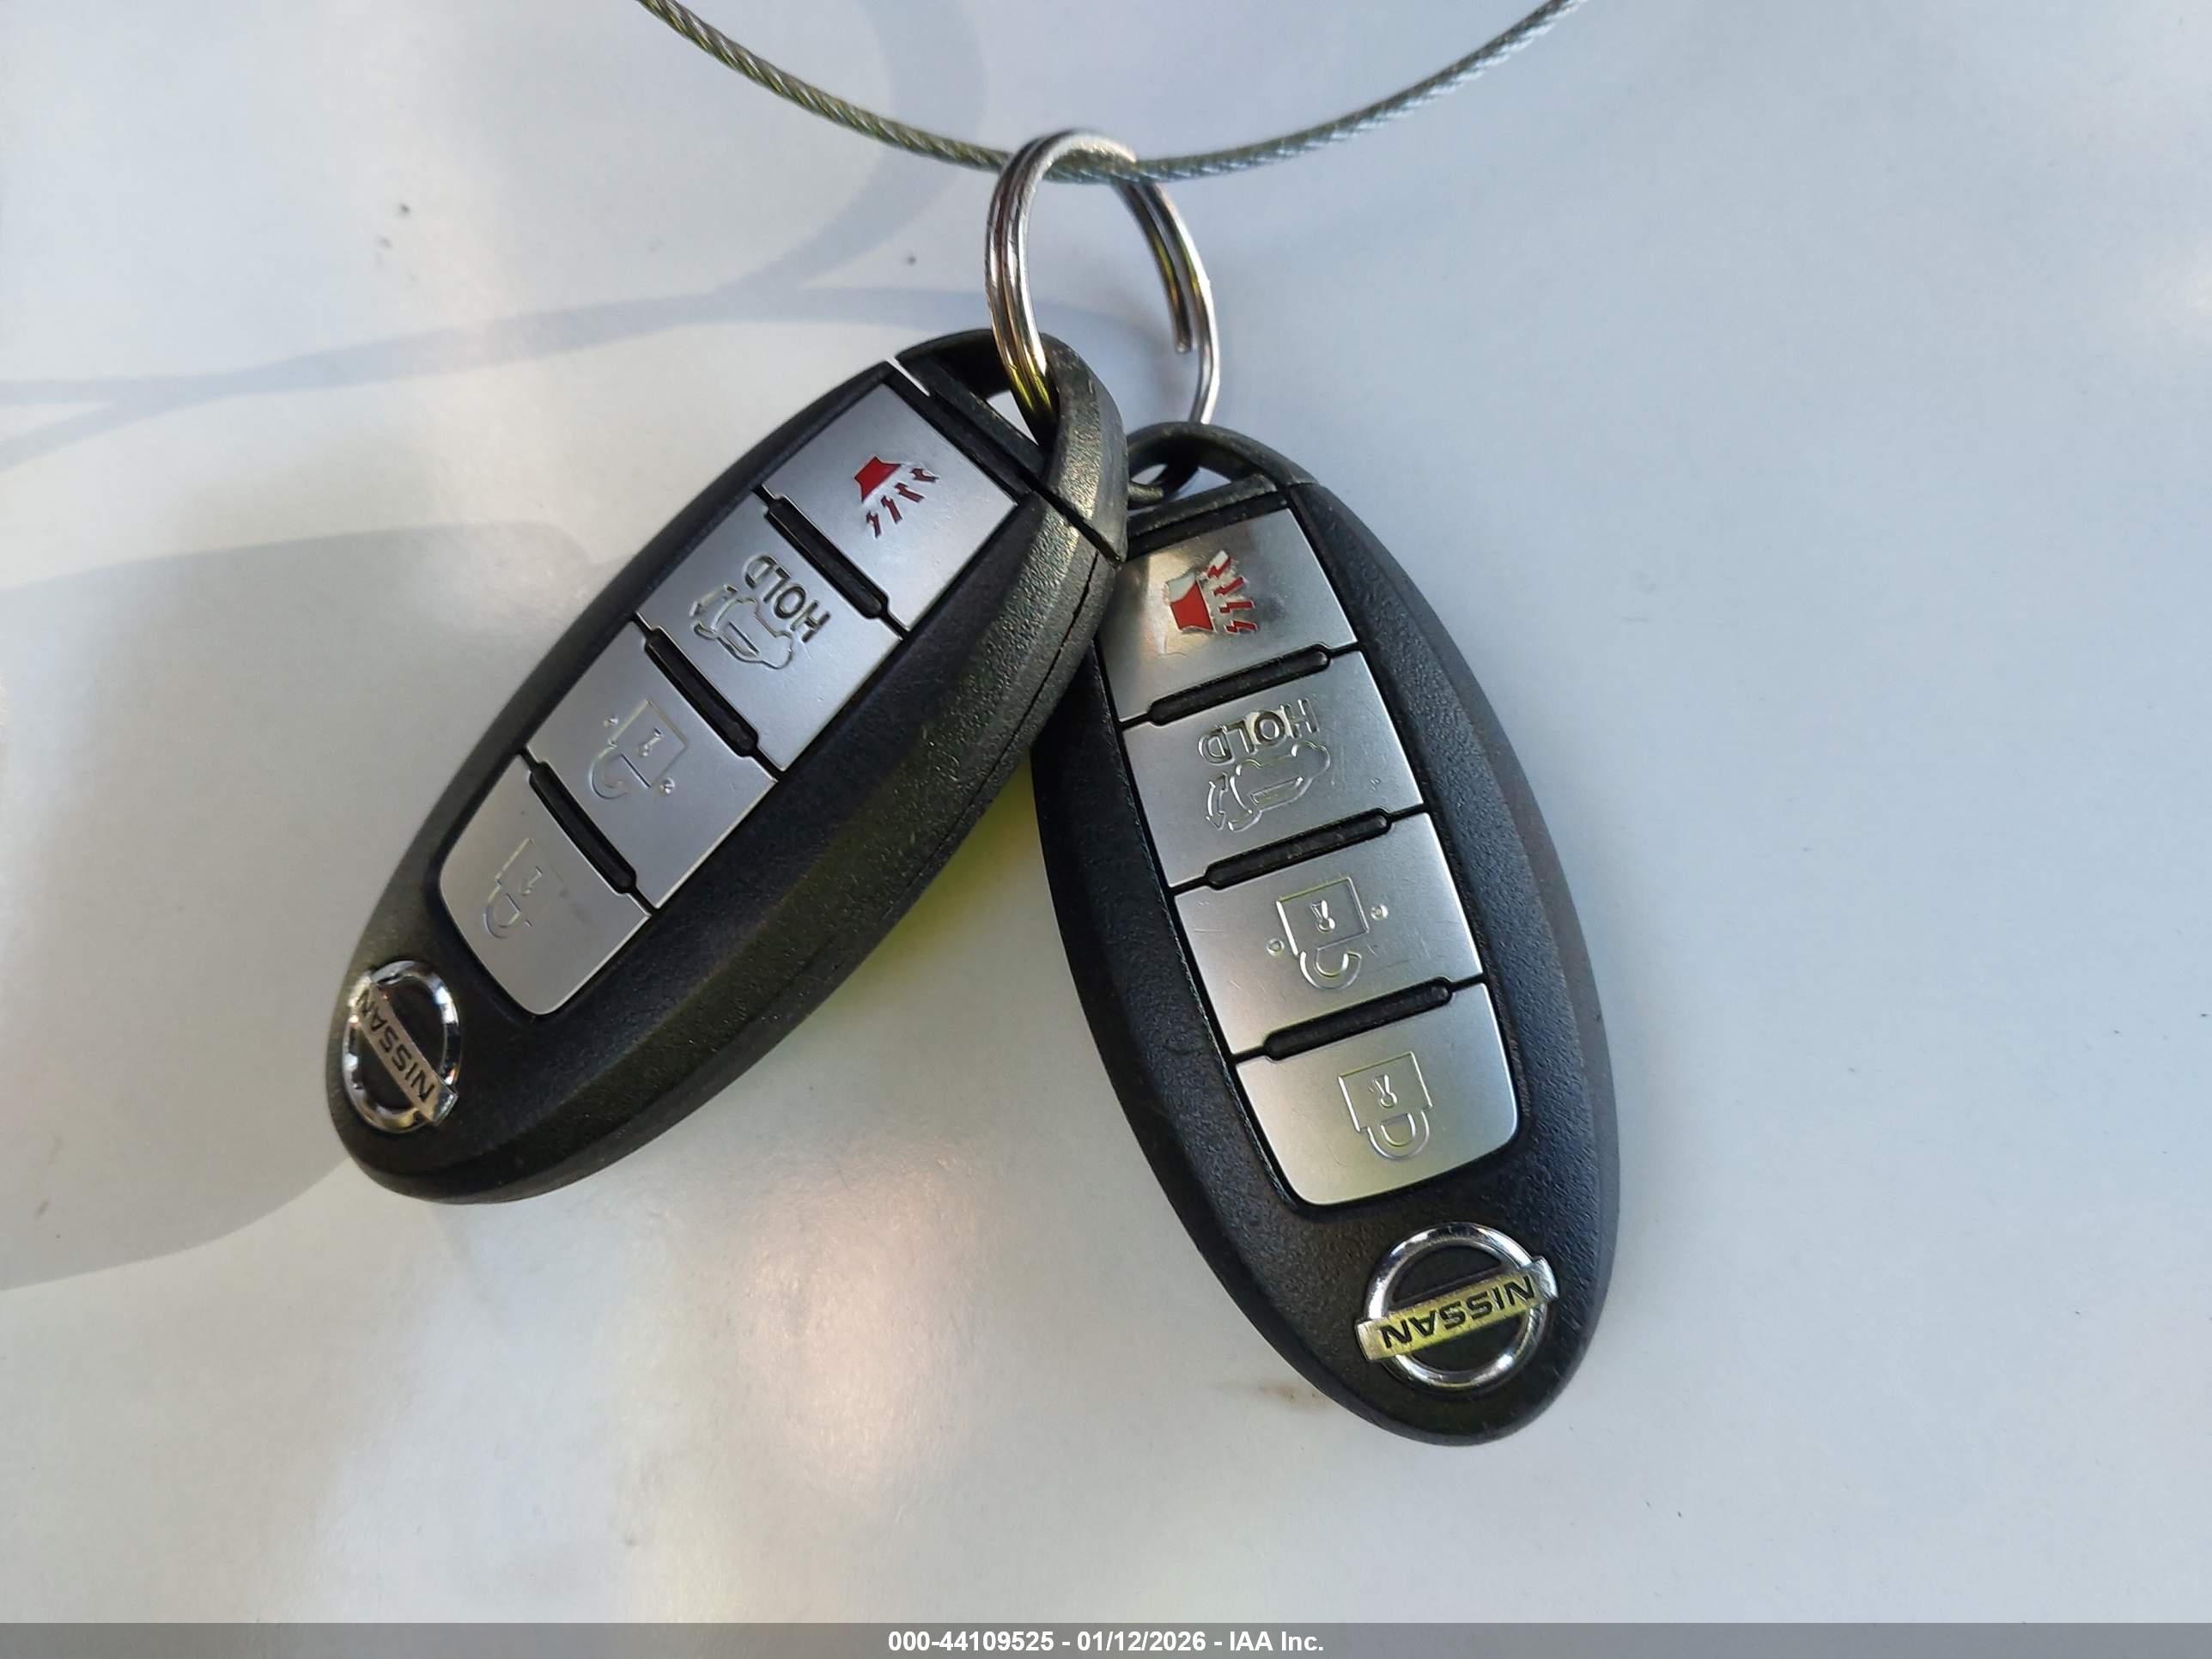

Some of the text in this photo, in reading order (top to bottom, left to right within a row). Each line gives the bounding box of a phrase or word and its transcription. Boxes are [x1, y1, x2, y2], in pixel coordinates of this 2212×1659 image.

[744, 556, 830, 643] HOLD
[1198, 697, 1321, 766] HOLD
[356, 988, 435, 1102] NISSAN
[1377, 1275, 1535, 1349] NISSAN
